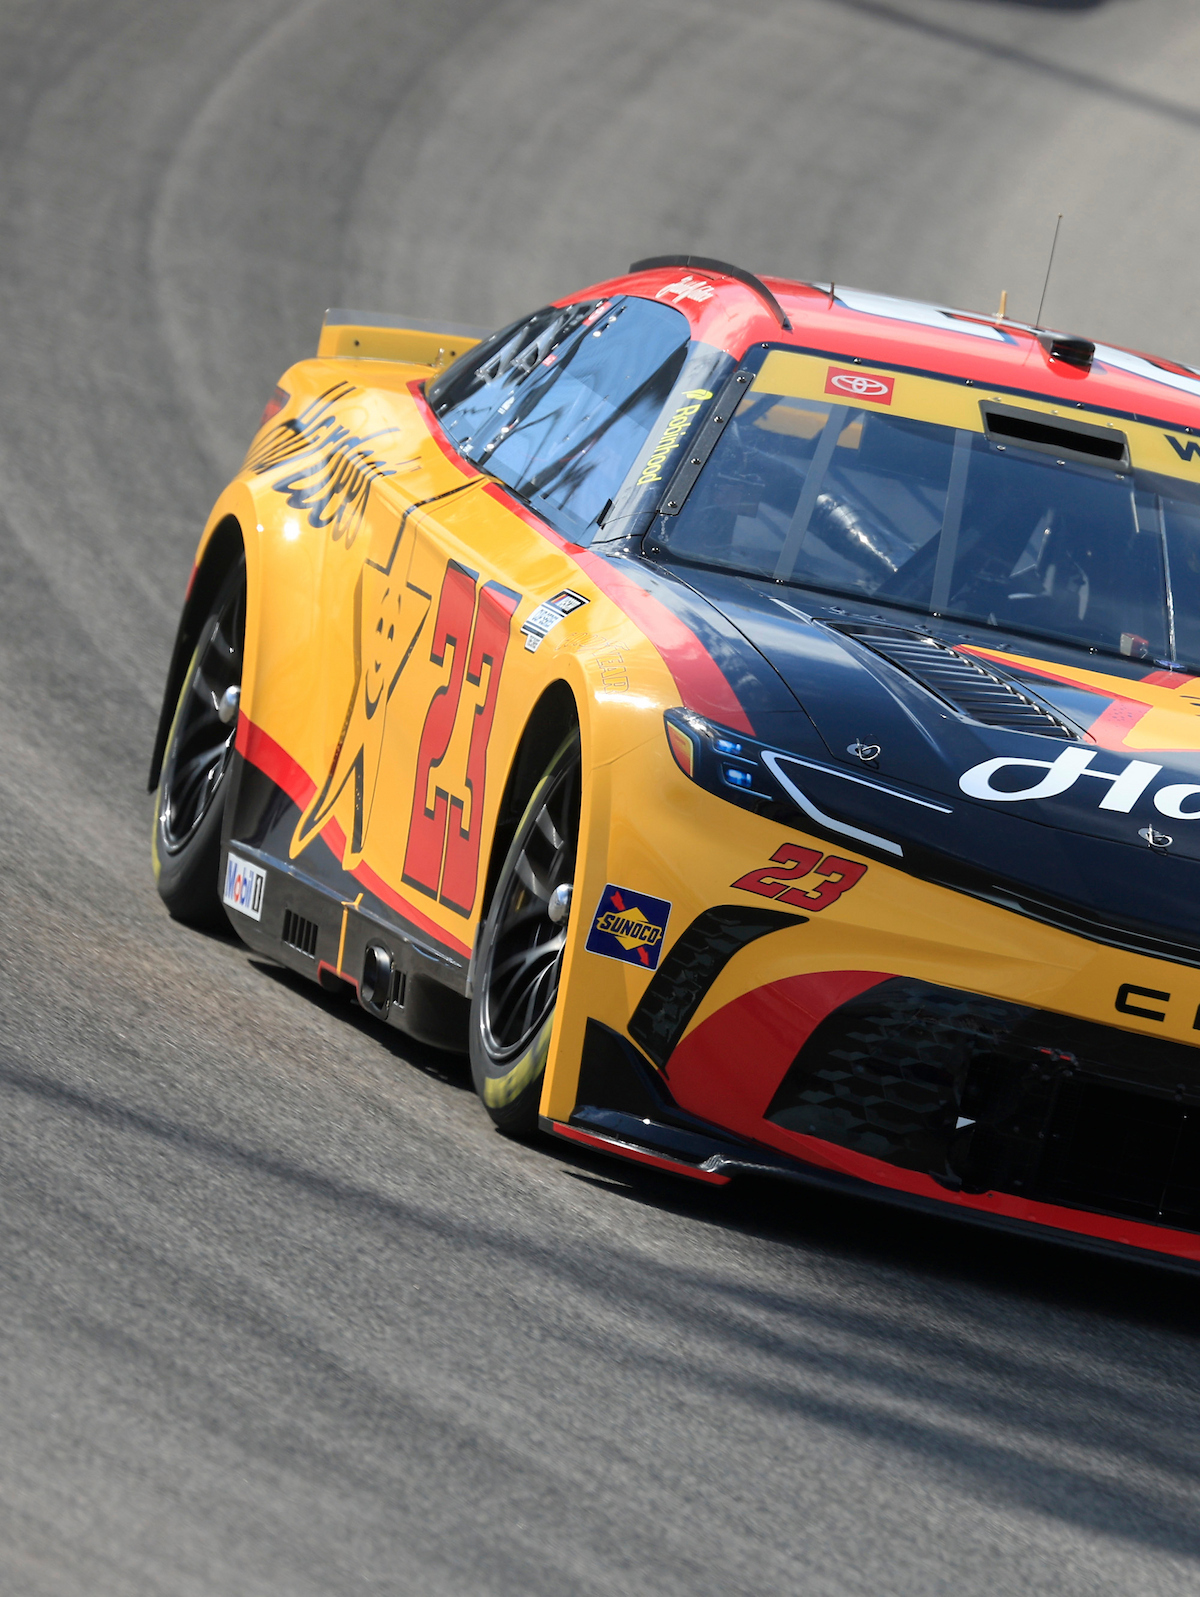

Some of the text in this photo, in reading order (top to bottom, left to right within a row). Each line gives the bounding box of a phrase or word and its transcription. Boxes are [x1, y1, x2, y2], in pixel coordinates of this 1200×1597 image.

[636, 403, 701, 486] Robinhood
[400, 558, 523, 920] 23
[225, 859, 255, 909] Mobil
[729, 842, 868, 912] 23
[600, 914, 661, 943] SUNOCO
